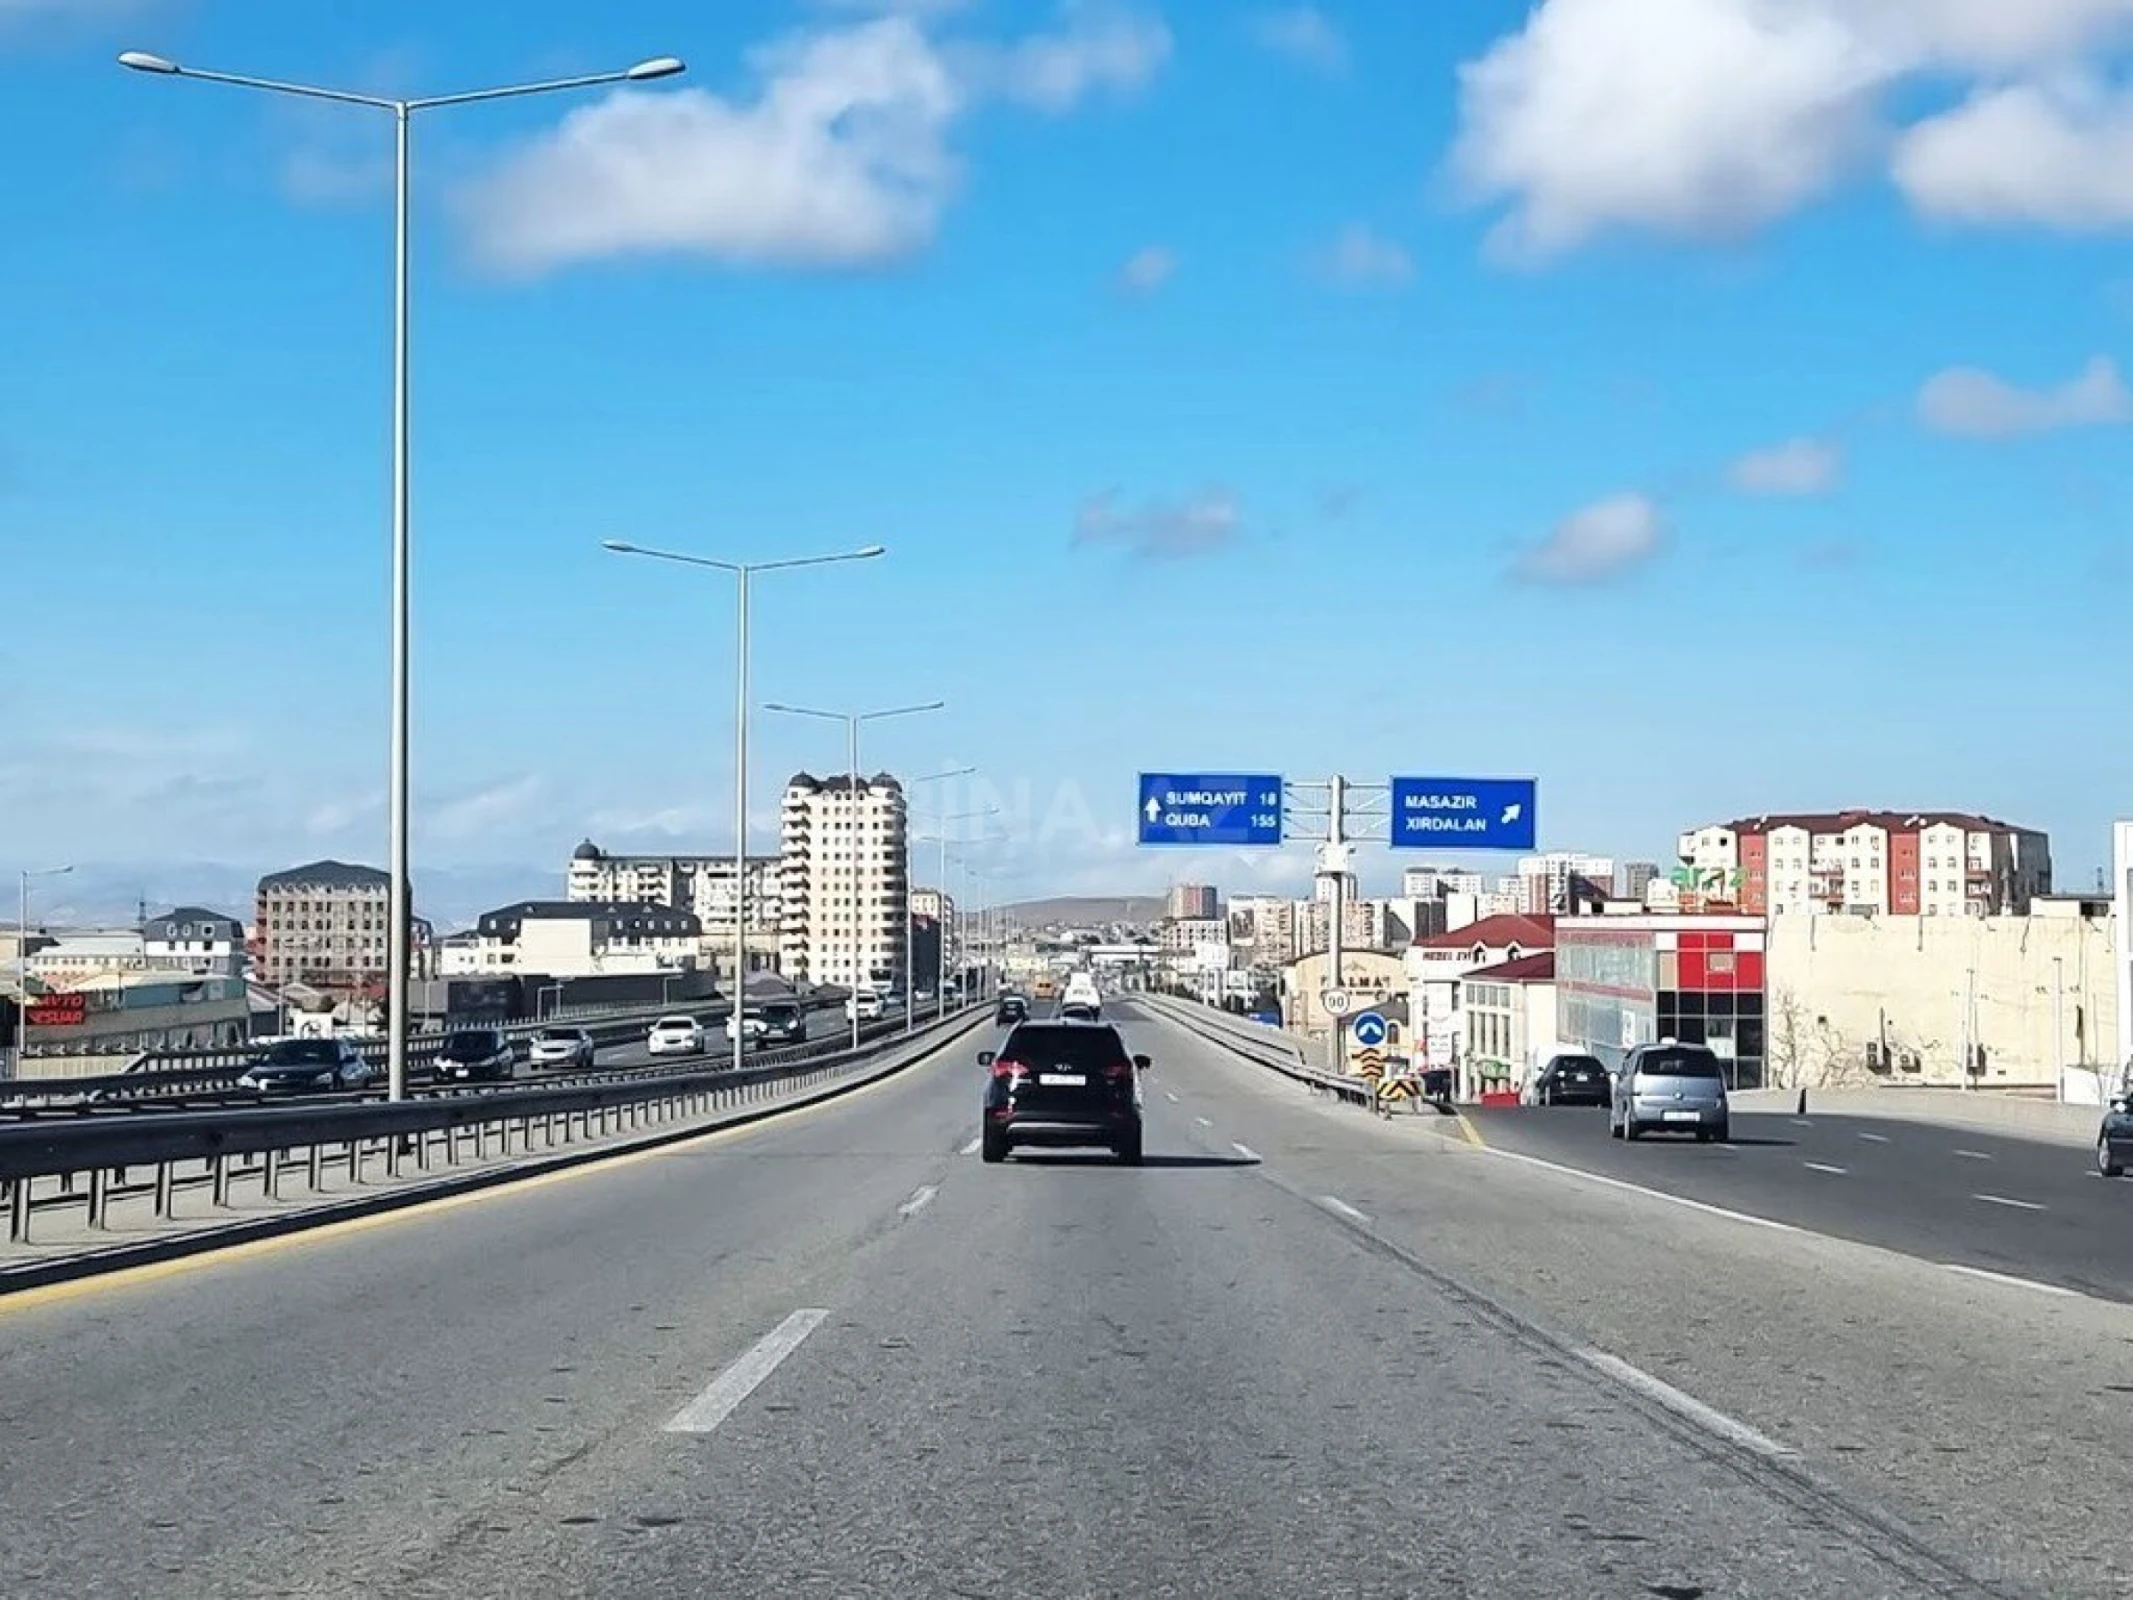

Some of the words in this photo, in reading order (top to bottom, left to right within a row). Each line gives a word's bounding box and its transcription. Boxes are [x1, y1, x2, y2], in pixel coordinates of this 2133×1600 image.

[1166, 791, 1247, 806] SUMQAYIT
[1259, 791, 1277, 806] 18
[1404, 795, 1477, 809] MASAZIR
[1165, 813, 1211, 828] QUBA
[1251, 813, 1276, 828] 155
[1405, 817, 1486, 832] XIRDALAN
